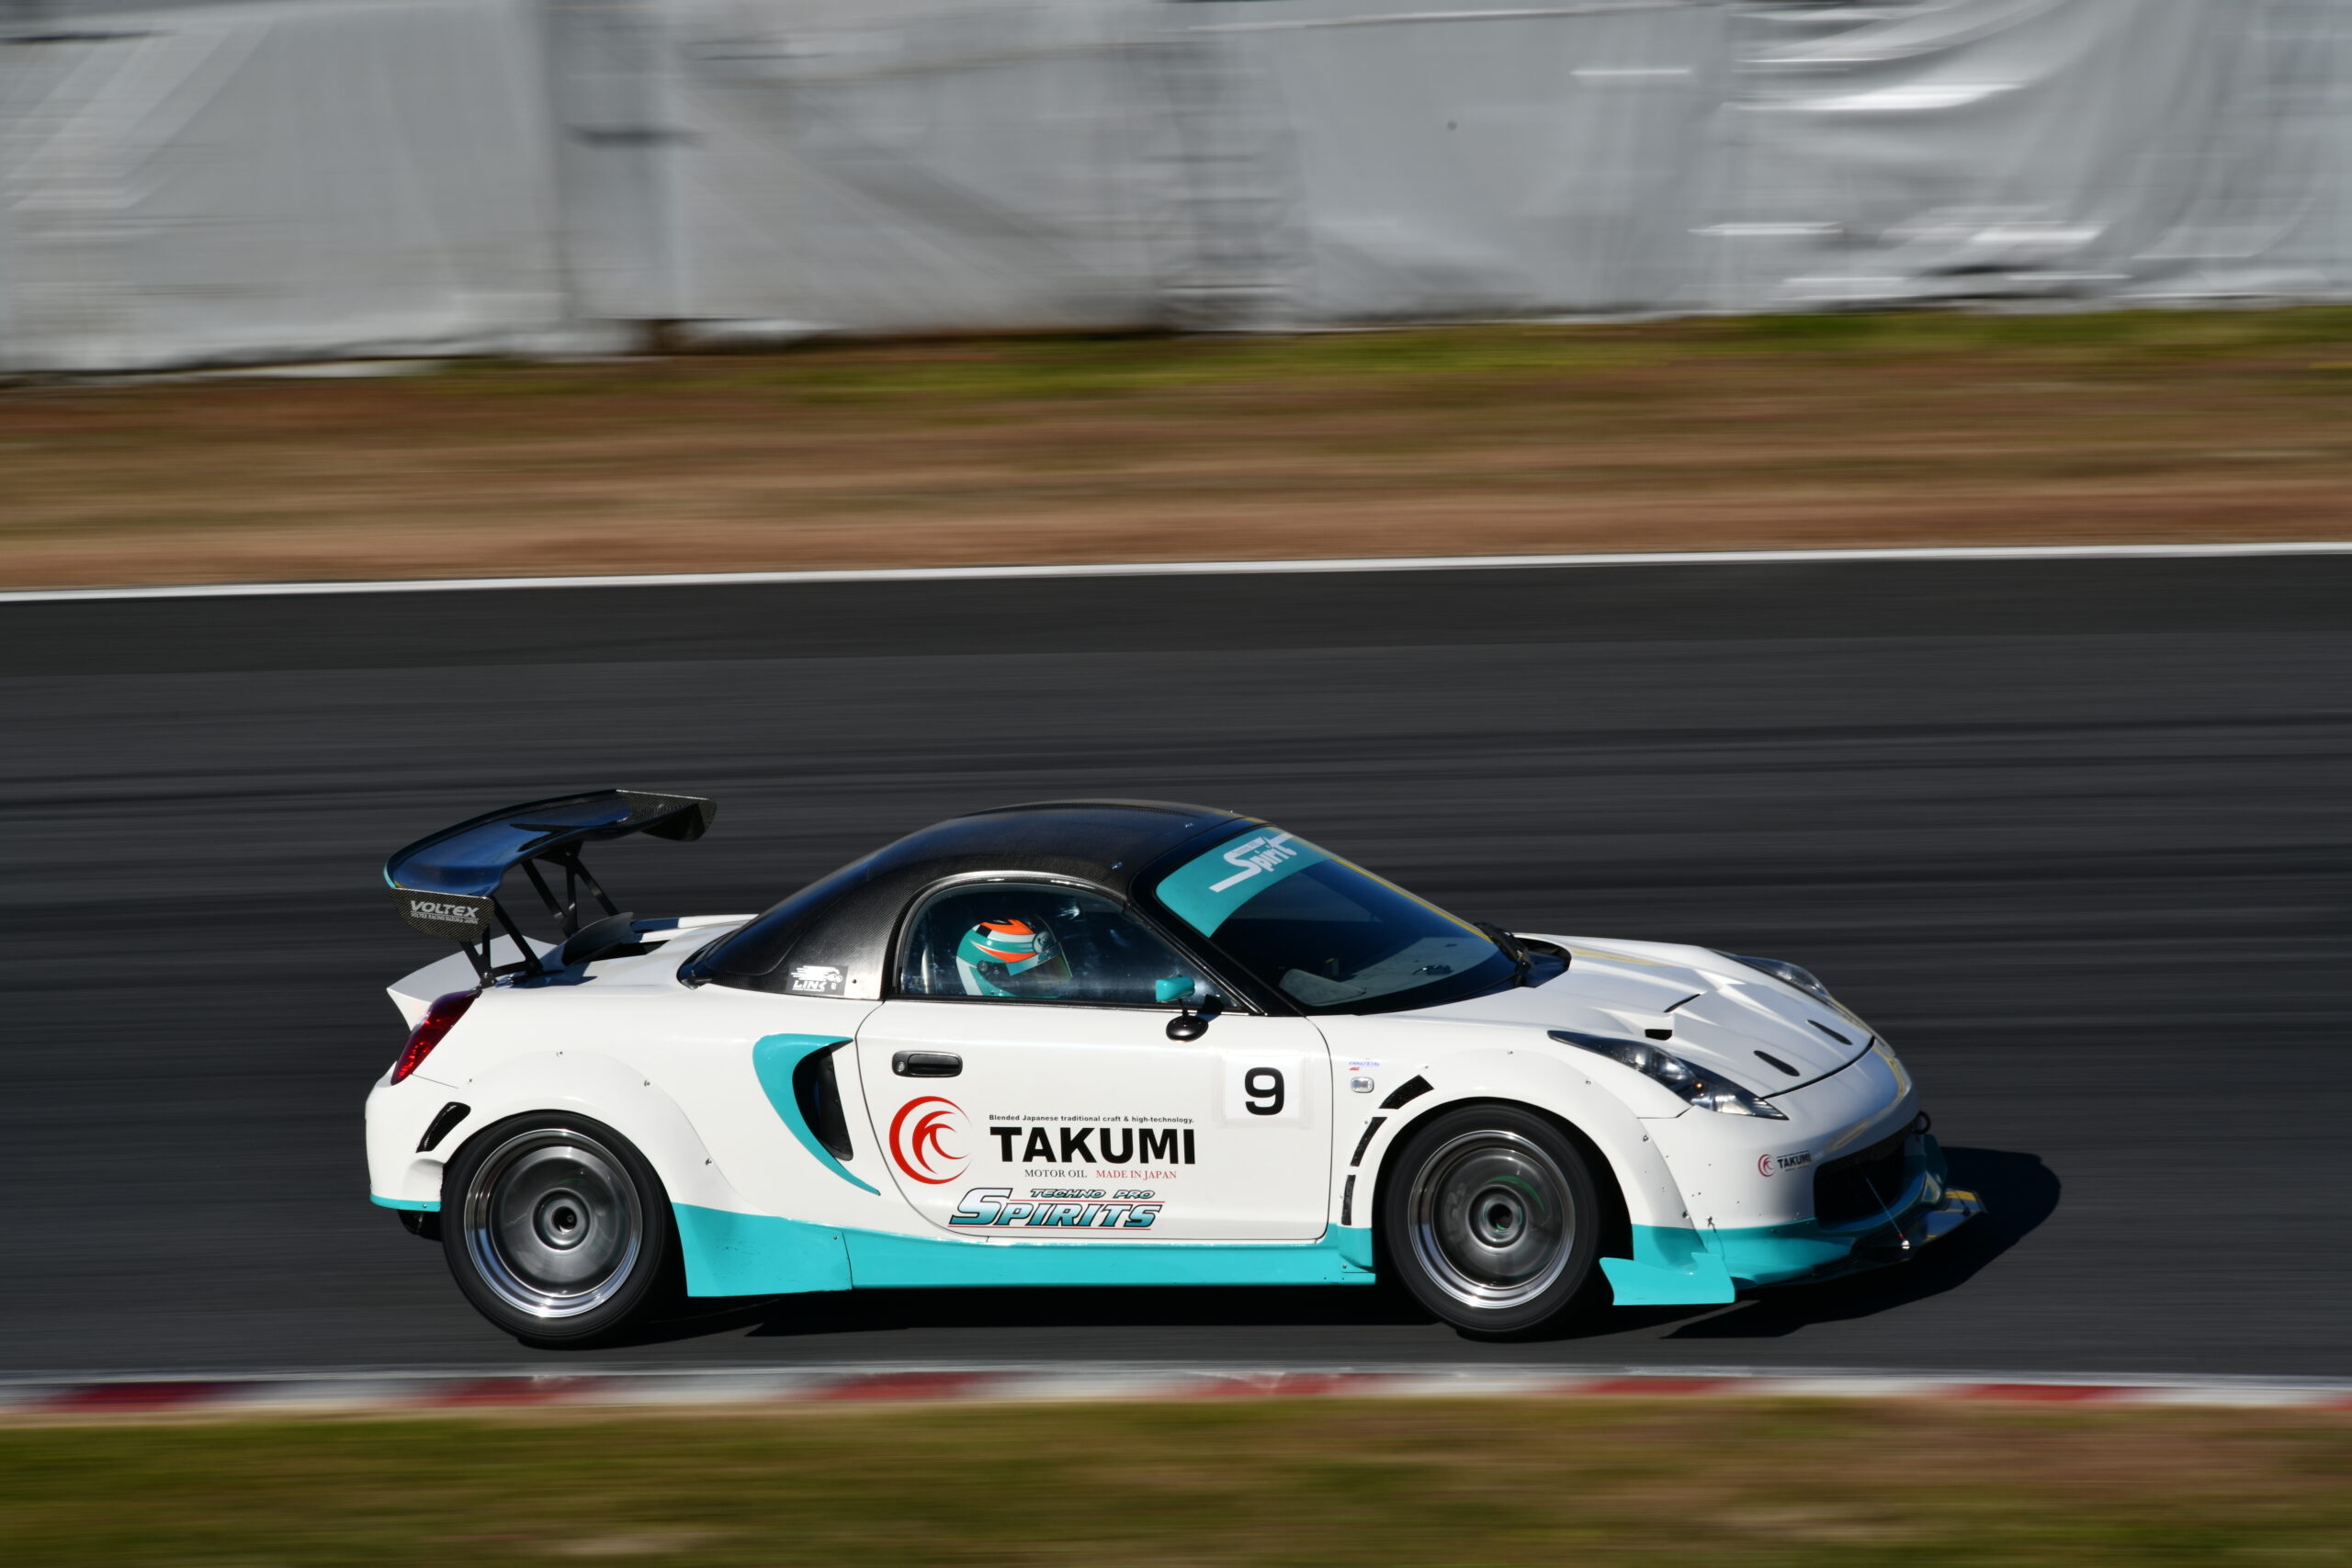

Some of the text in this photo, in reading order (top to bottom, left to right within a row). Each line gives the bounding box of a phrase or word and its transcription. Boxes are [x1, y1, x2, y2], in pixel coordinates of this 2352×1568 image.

[411, 900, 480, 918] VOLTEX
[1244, 1066, 1284, 1116] 9
[1022, 1114, 1058, 1122] Japanese
[1131, 1116, 1194, 1124] high-technology.
[989, 1126, 1196, 1165] TAKUMI
[1777, 1152, 1812, 1169] TAKUMI
[1024, 1168, 1177, 1181] MOTOR OIL MADE IN JAPAN
[1030, 1188, 1156, 1200] TECHNO PRO
[949, 1187, 1163, 1228] SPIRITS
